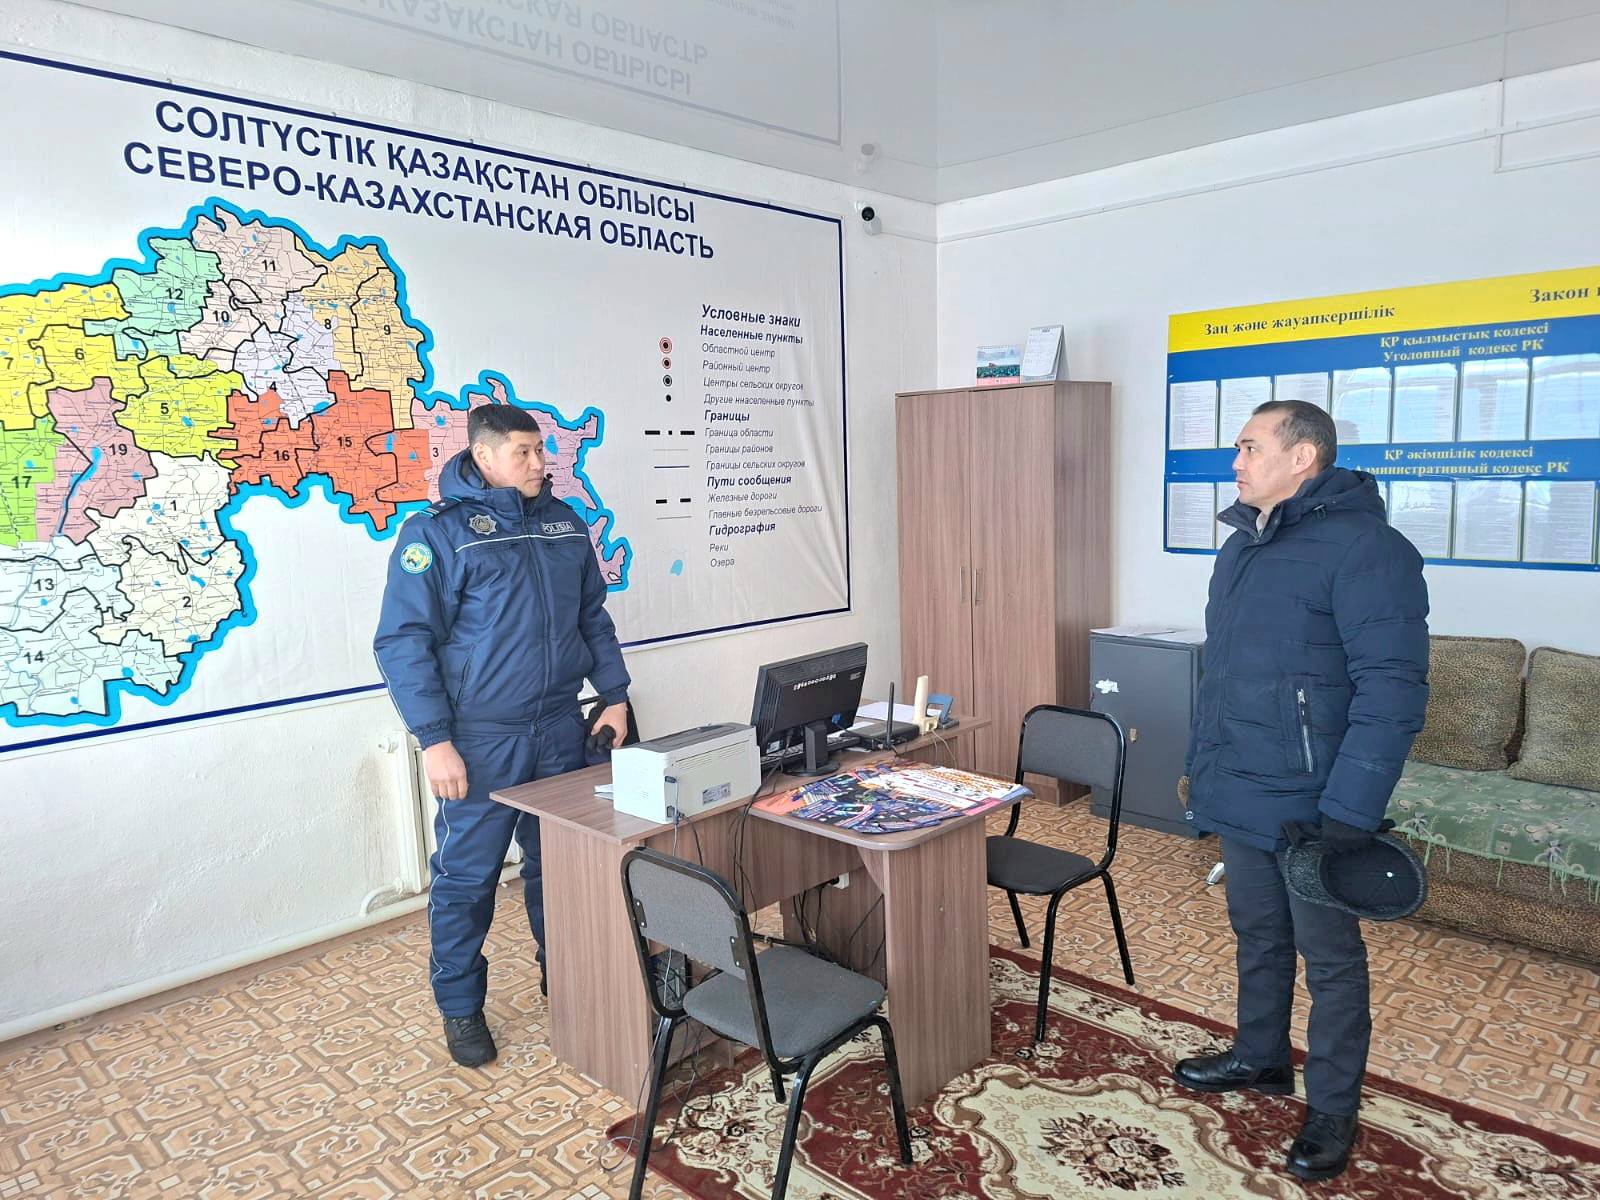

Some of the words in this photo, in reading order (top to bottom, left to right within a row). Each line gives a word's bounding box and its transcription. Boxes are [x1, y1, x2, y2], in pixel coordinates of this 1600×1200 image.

[155, 100, 376, 166] СОЛТҮСТІК
[387, 142, 569, 201] ҚАЗАҚСТАН
[577, 180, 695, 223] ОБЛЫСЫ
[124, 142, 591, 241] СЕВЕРО-КАЗАХСТАНСКАЯ
[600, 219, 714, 259] ОБЛАСТЬ
[261, 259, 277, 273] 11
[165, 287, 183, 301] 12
[1530, 288, 1590, 303] Закон
[212, 309, 230, 323] 10
[702, 303, 765, 324] Условные
[769, 313, 801, 327] знаки
[1203, 323, 1229, 337] Заң
[1233, 317, 1268, 333] және
[1271, 304, 1396, 331] жауапкершілік
[324, 317, 332, 330] 8
[383, 323, 391, 336] 9
[700, 324, 763, 341] Населенные
[766, 331, 803, 344] пункты
[1380, 336, 1400, 349] ҚР
[1403, 329, 1490, 346] қылмыстық
[1493, 321, 1550, 338] кодексі
[75, 347, 85, 360] 6
[702, 343, 748, 355] Областной
[751, 348, 776, 359] центр
[1383, 344, 1461, 363] Уголовный
[1468, 343, 1518, 356] кодекс
[1522, 338, 1545, 351] РК
[4, 357, 14, 369] 7
[702, 360, 743, 372] Районный
[745, 364, 771, 374] центр
[269, 380, 277, 392] 4
[703, 377, 737, 390] Центры
[740, 380, 773, 389] сельских
[704, 393, 733, 405] Другие
[160, 402, 168, 414] 5
[704, 409, 750, 422] Границы
[704, 427, 738, 438] Граница
[740, 427, 774, 438] области
[337, 437, 352, 448] 15
[108, 443, 127, 456] 19
[274, 450, 290, 461] 16
[432, 447, 439, 457] 3
[705, 444, 740, 455] Границы
[1384, 449, 1403, 461] ҚР
[1407, 448, 1475, 460] әкімшілік
[1480, 446, 1533, 459] кодексі
[706, 460, 741, 471] Границы
[1492, 463, 1542, 475] кодекс
[1547, 461, 1569, 473] РК
[11, 475, 31, 489] 17
[707, 476, 735, 489] Пути
[738, 474, 791, 486] сообщения
[708, 493, 748, 503] Железные
[750, 491, 778, 502] дороги
[170, 500, 176, 511] 1
[709, 509, 742, 520] Главные
[709, 522, 776, 537] Гидрография
[709, 542, 729, 553] Реки
[710, 557, 735, 568] Озера
[33, 578, 54, 592] 13
[183, 595, 191, 608] 2
[23, 650, 45, 665] 14
